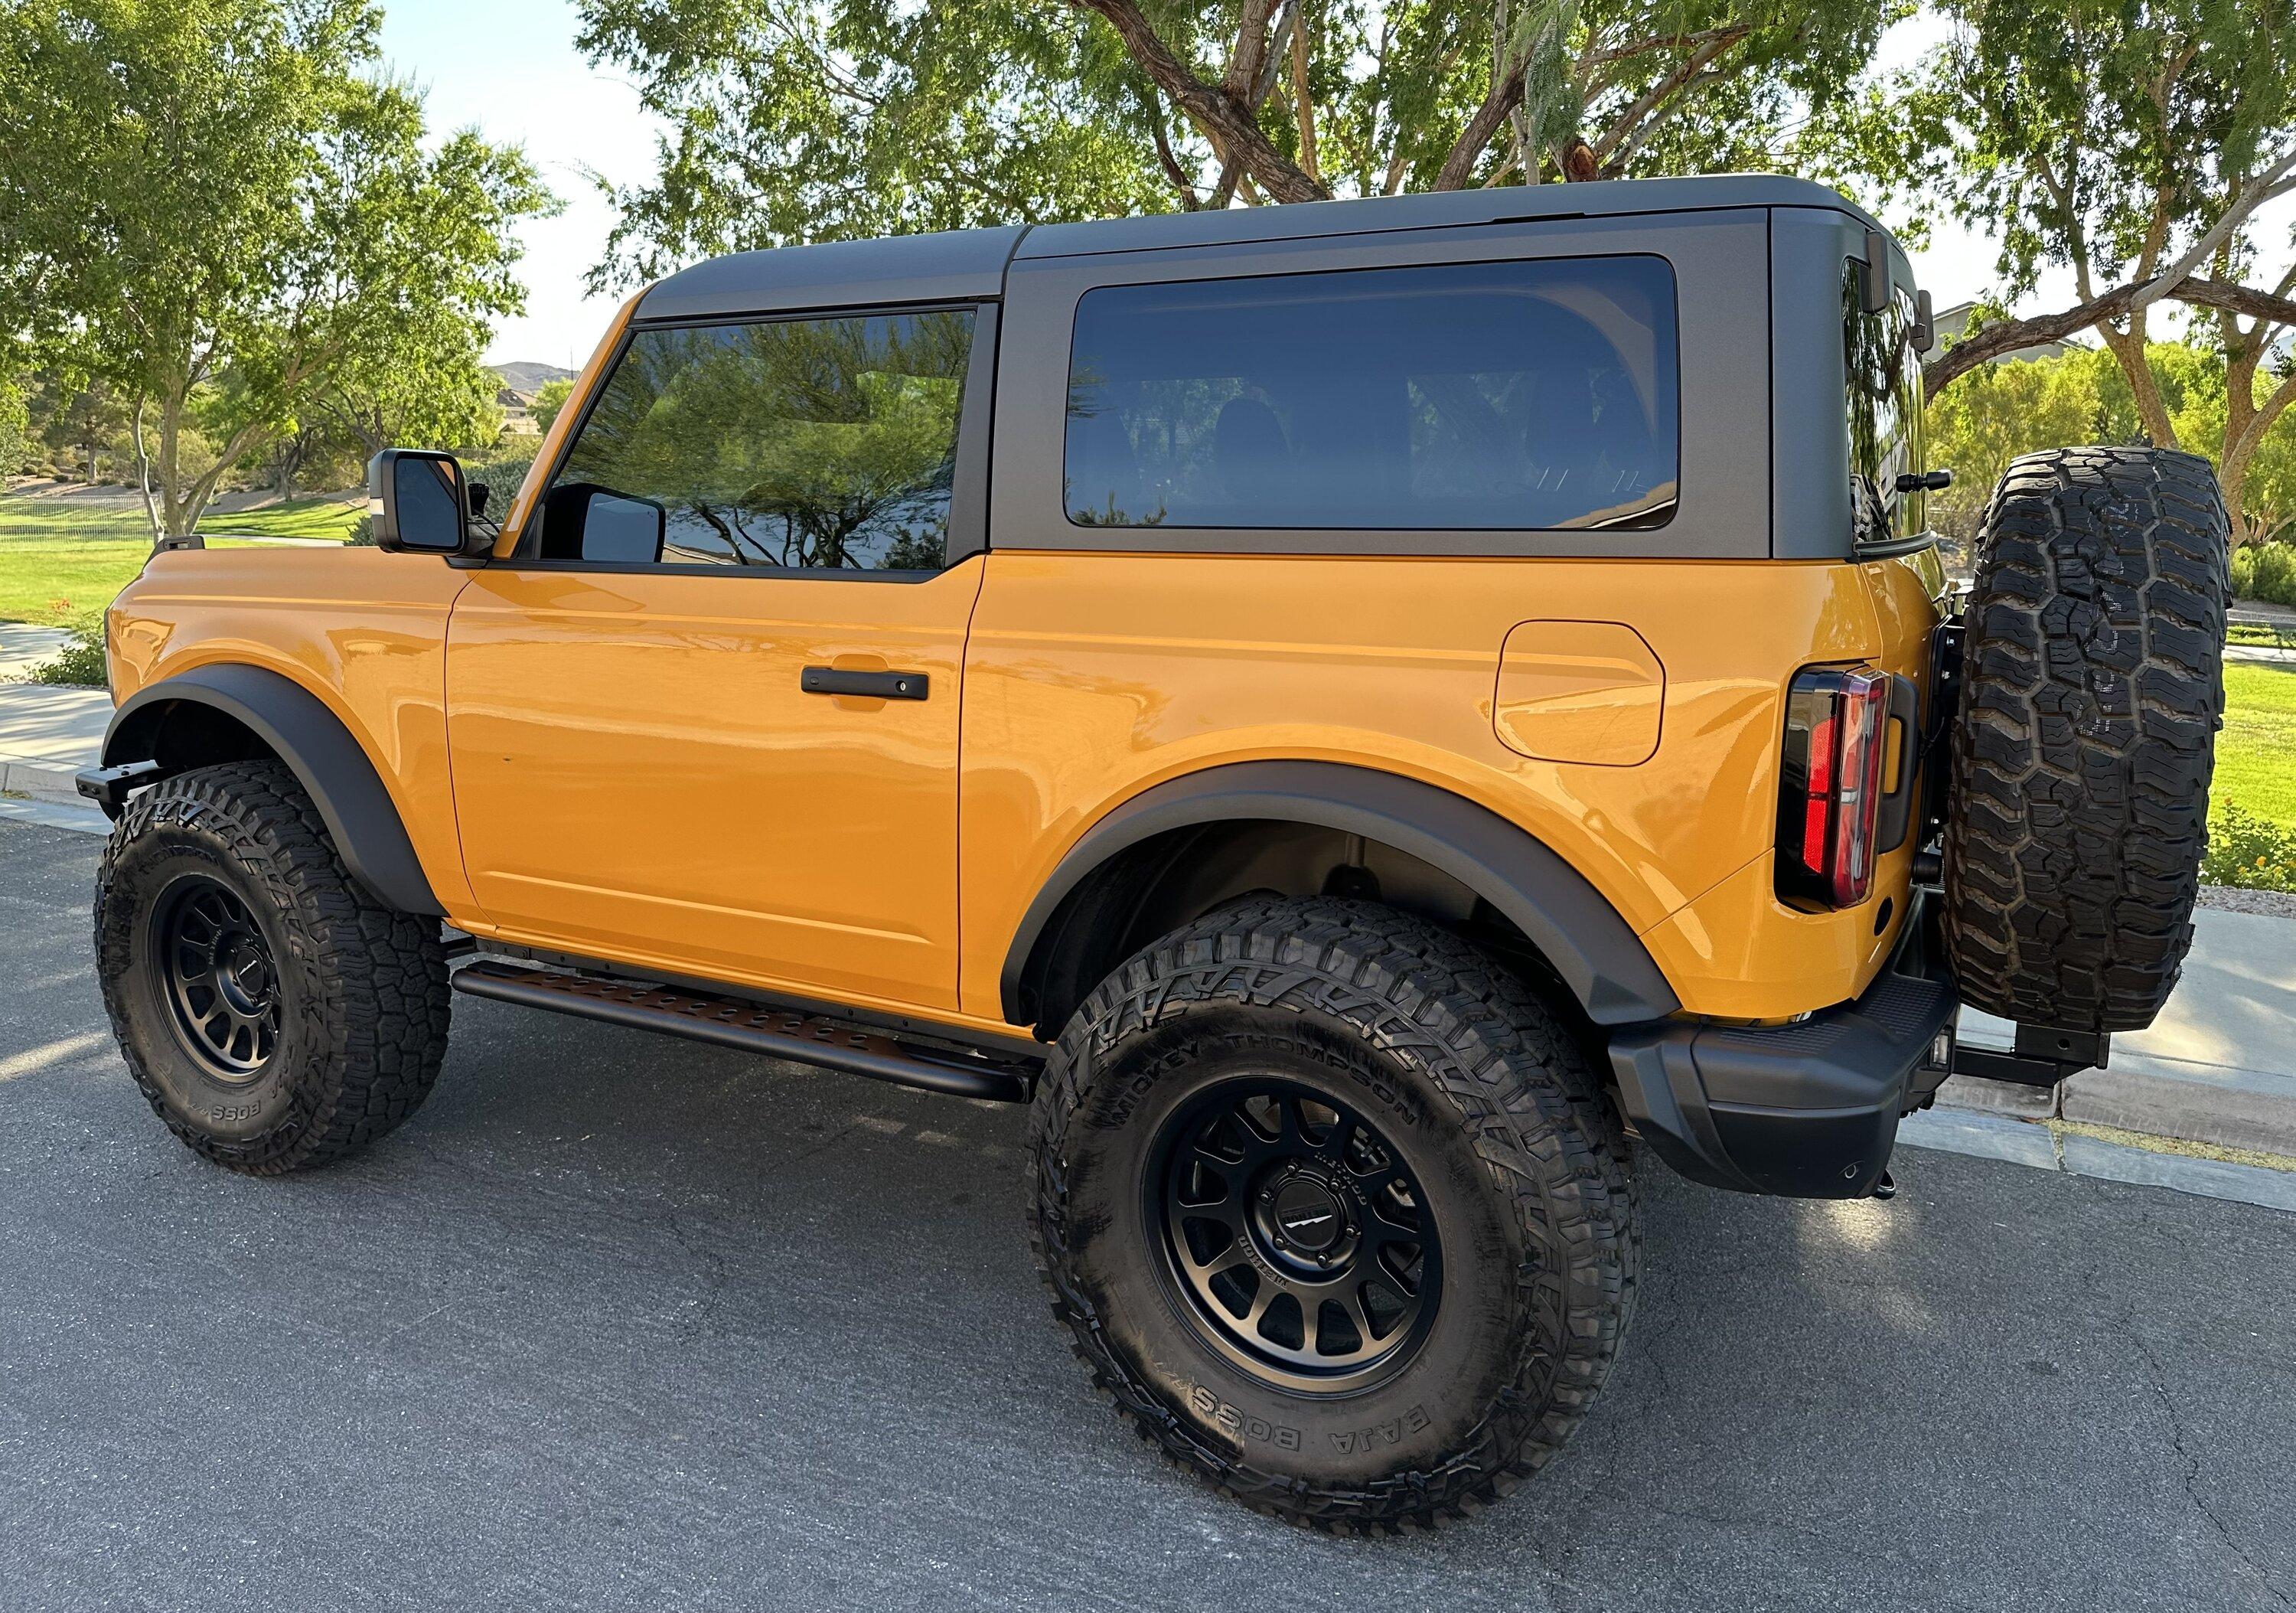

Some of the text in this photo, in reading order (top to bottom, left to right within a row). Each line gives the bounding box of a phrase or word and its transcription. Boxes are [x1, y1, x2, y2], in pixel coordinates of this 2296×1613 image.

[1112, 1032, 1417, 1127] MICKEY THOMPSON
[212, 1099, 261, 1121] BOSS
[1238, 1235, 1290, 1291] METHOD
[1192, 1384, 1301, 1452] BOSS
[1328, 1403, 1432, 1455] BAJA
